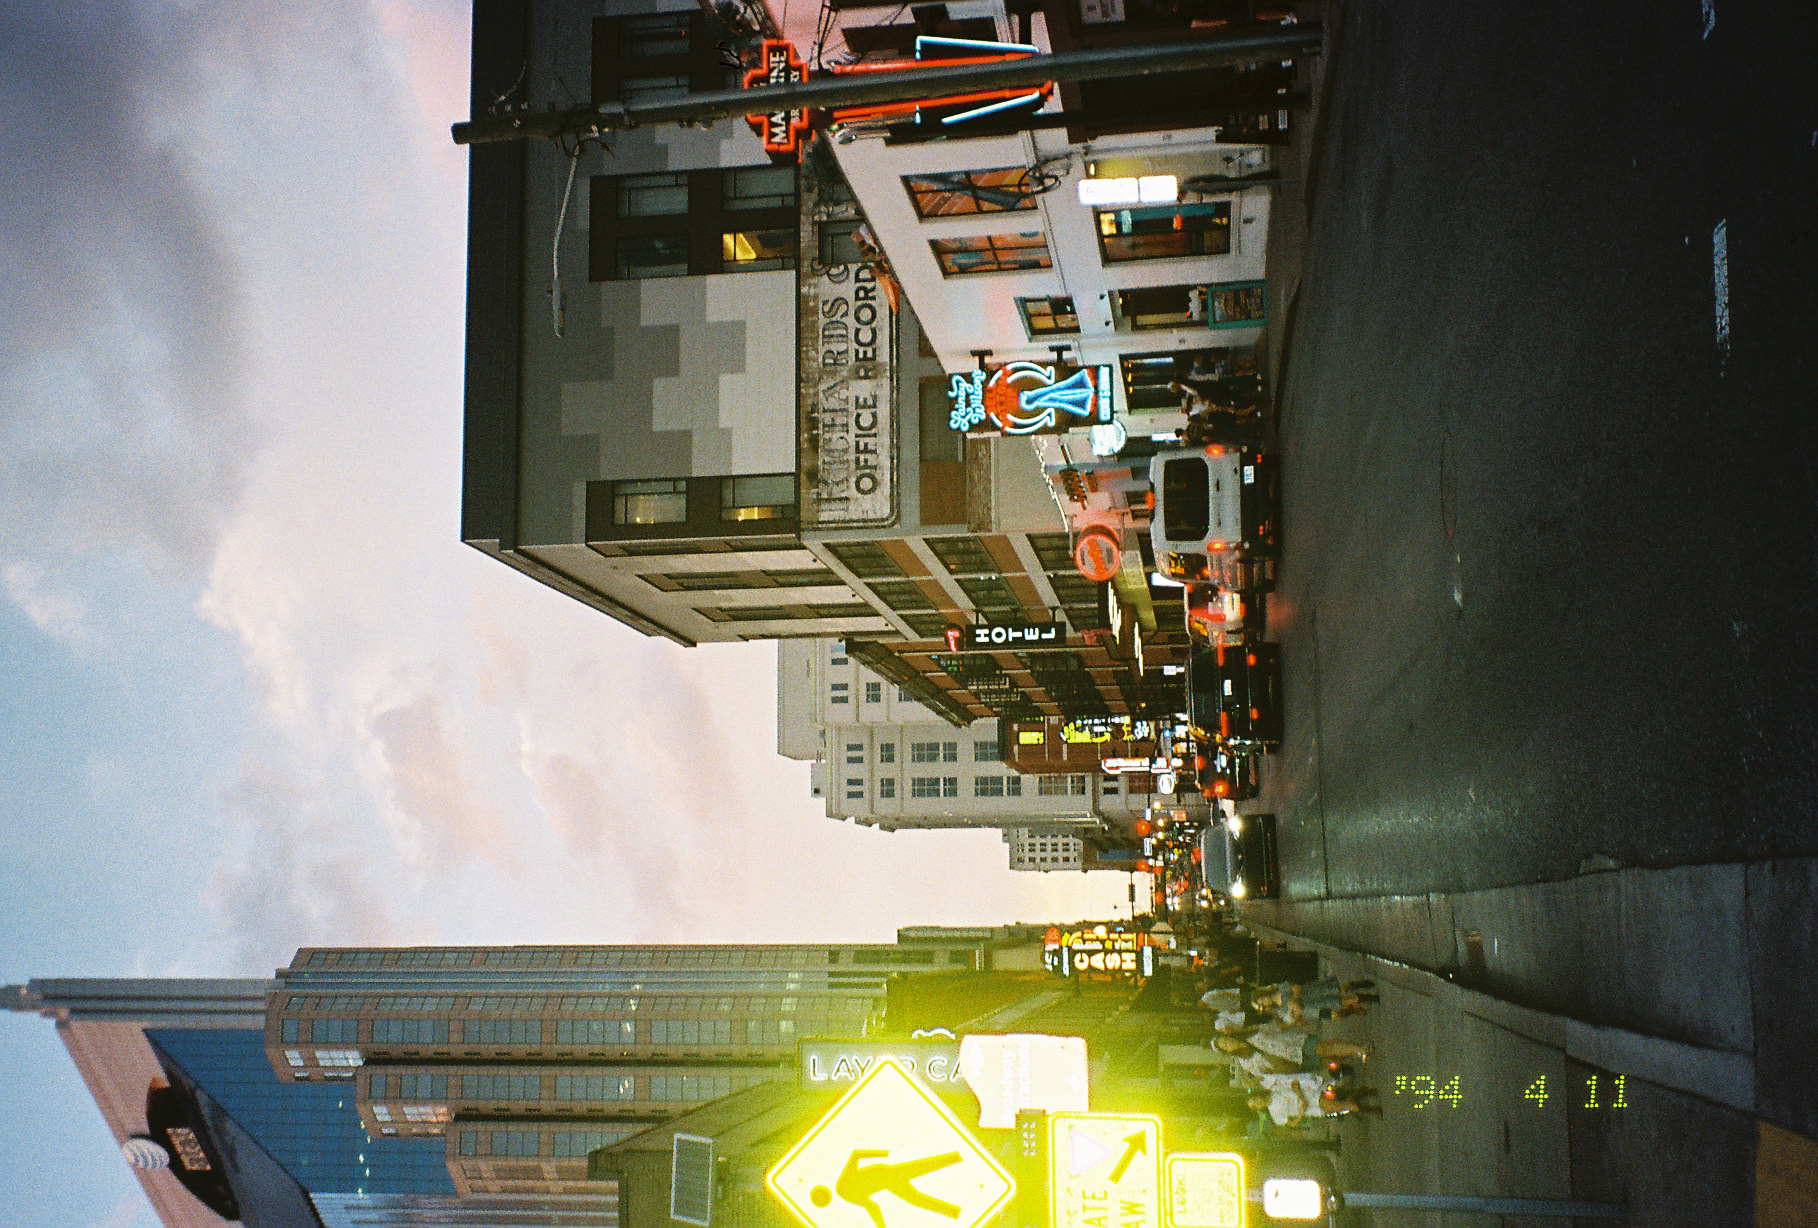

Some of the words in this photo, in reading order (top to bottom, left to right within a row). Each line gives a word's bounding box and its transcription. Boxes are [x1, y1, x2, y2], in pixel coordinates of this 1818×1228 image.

[854, 262, 878, 380] RECORD
[947, 373, 975, 432] Lainey
[969, 368, 987, 425] Wilson's
[854, 394, 878, 496] OFFICE
[975, 626, 1056, 644] HOTEL
[1072, 951, 1137, 971] CASH
[1000, 1049, 1017, 1124] Broadway
[1016, 1039, 1031, 1108] tractions
